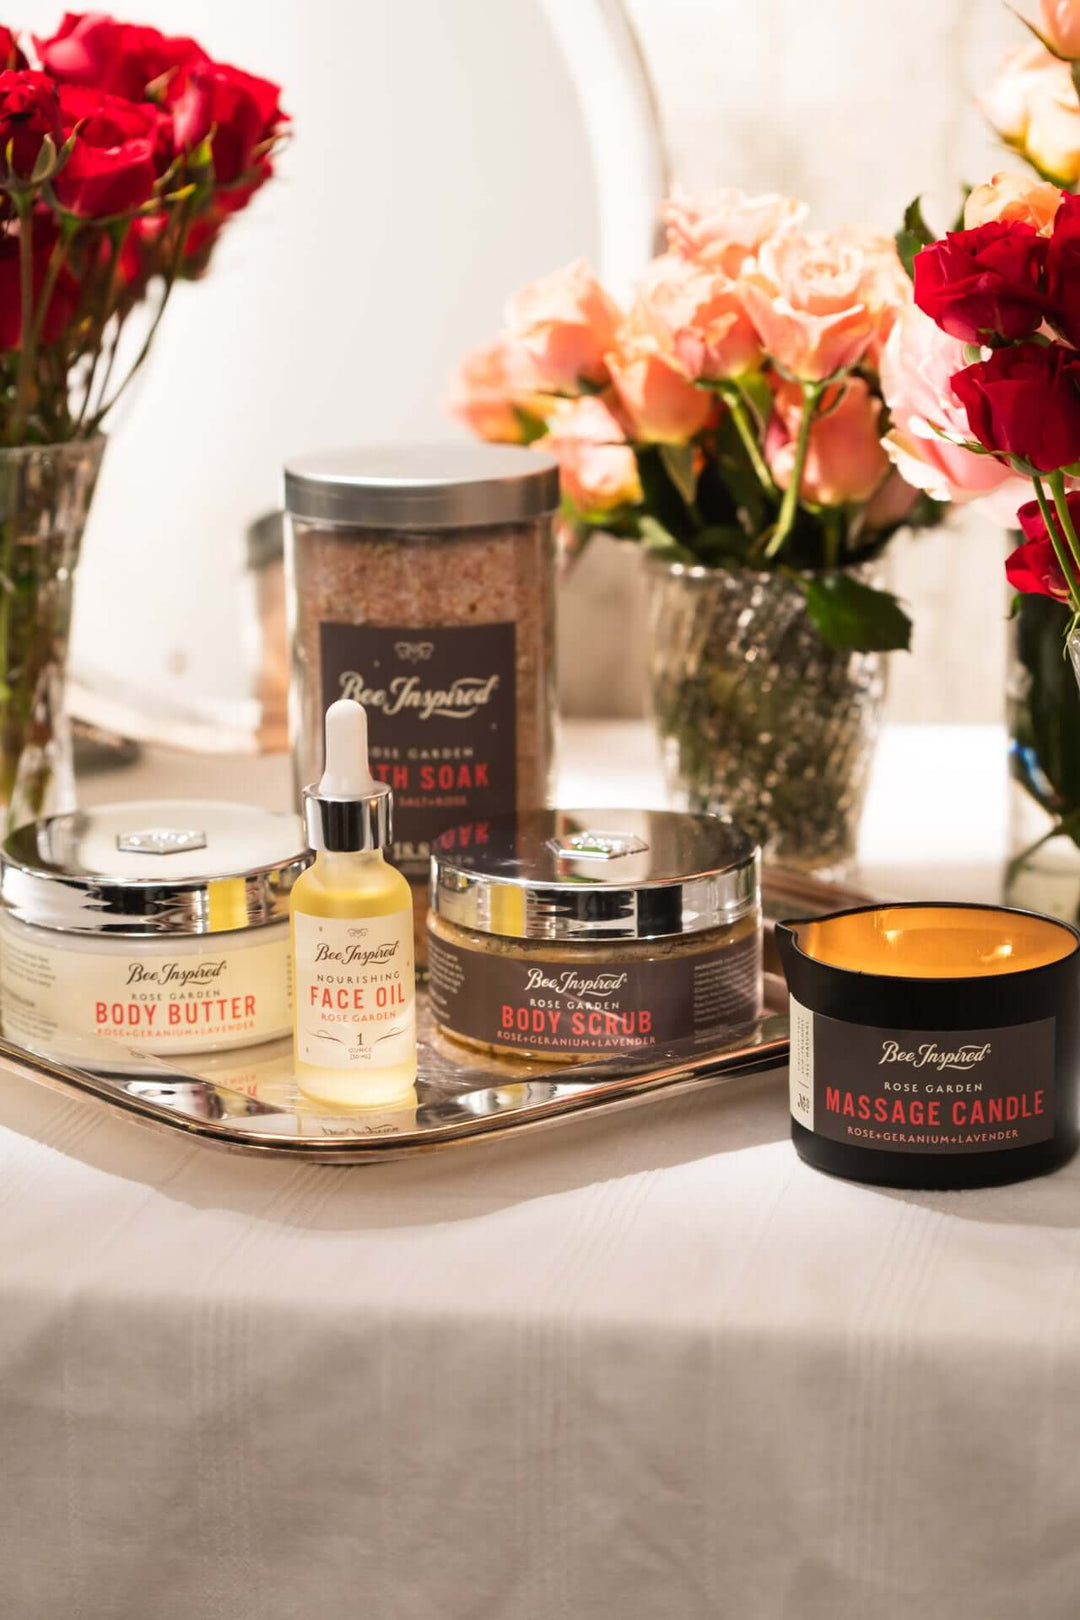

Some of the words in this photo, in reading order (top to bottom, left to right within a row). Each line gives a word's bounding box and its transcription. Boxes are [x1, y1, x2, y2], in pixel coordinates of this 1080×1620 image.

[339, 671, 386, 706] Bee
[382, 674, 499, 720] Inspired
[370, 746, 399, 758] OSE
[369, 762, 409, 790] TH
[419, 762, 489, 791] SOAK
[315, 942, 343, 962] Bee
[341, 940, 400, 965] Inspired
[126, 963, 159, 985] Bee
[157, 960, 227, 986] Inspired
[317, 970, 400, 984] NOURISHING
[524, 968, 558, 991] Bee
[555, 971, 627, 997] Inspired
[131, 993, 163, 1001] ROSE
[169, 990, 221, 1000] GARDEN
[310, 985, 365, 1010] FACE
[376, 984, 406, 1008] OIL
[529, 998, 561, 1009] ROSE
[567, 1000, 620, 1010] GARDEN
[96, 1002, 157, 1026] BODY
[168, 995, 257, 1025] BUTTER
[321, 1013, 349, 1023] ROSE
[352, 1011, 397, 1023] GARDEN
[501, 1005, 560, 1034] BODY
[571, 1010, 653, 1036] SCRUB
[357, 1033, 364, 1046] 1
[877, 1040, 917, 1065] Bee
[913, 1043, 991, 1071] Inspired
[884, 1081, 918, 1093] ROSE
[925, 1083, 983, 1094] GARDEN
[825, 1086, 941, 1126] MASSAGE
[952, 1090, 1045, 1126] CANDLE
